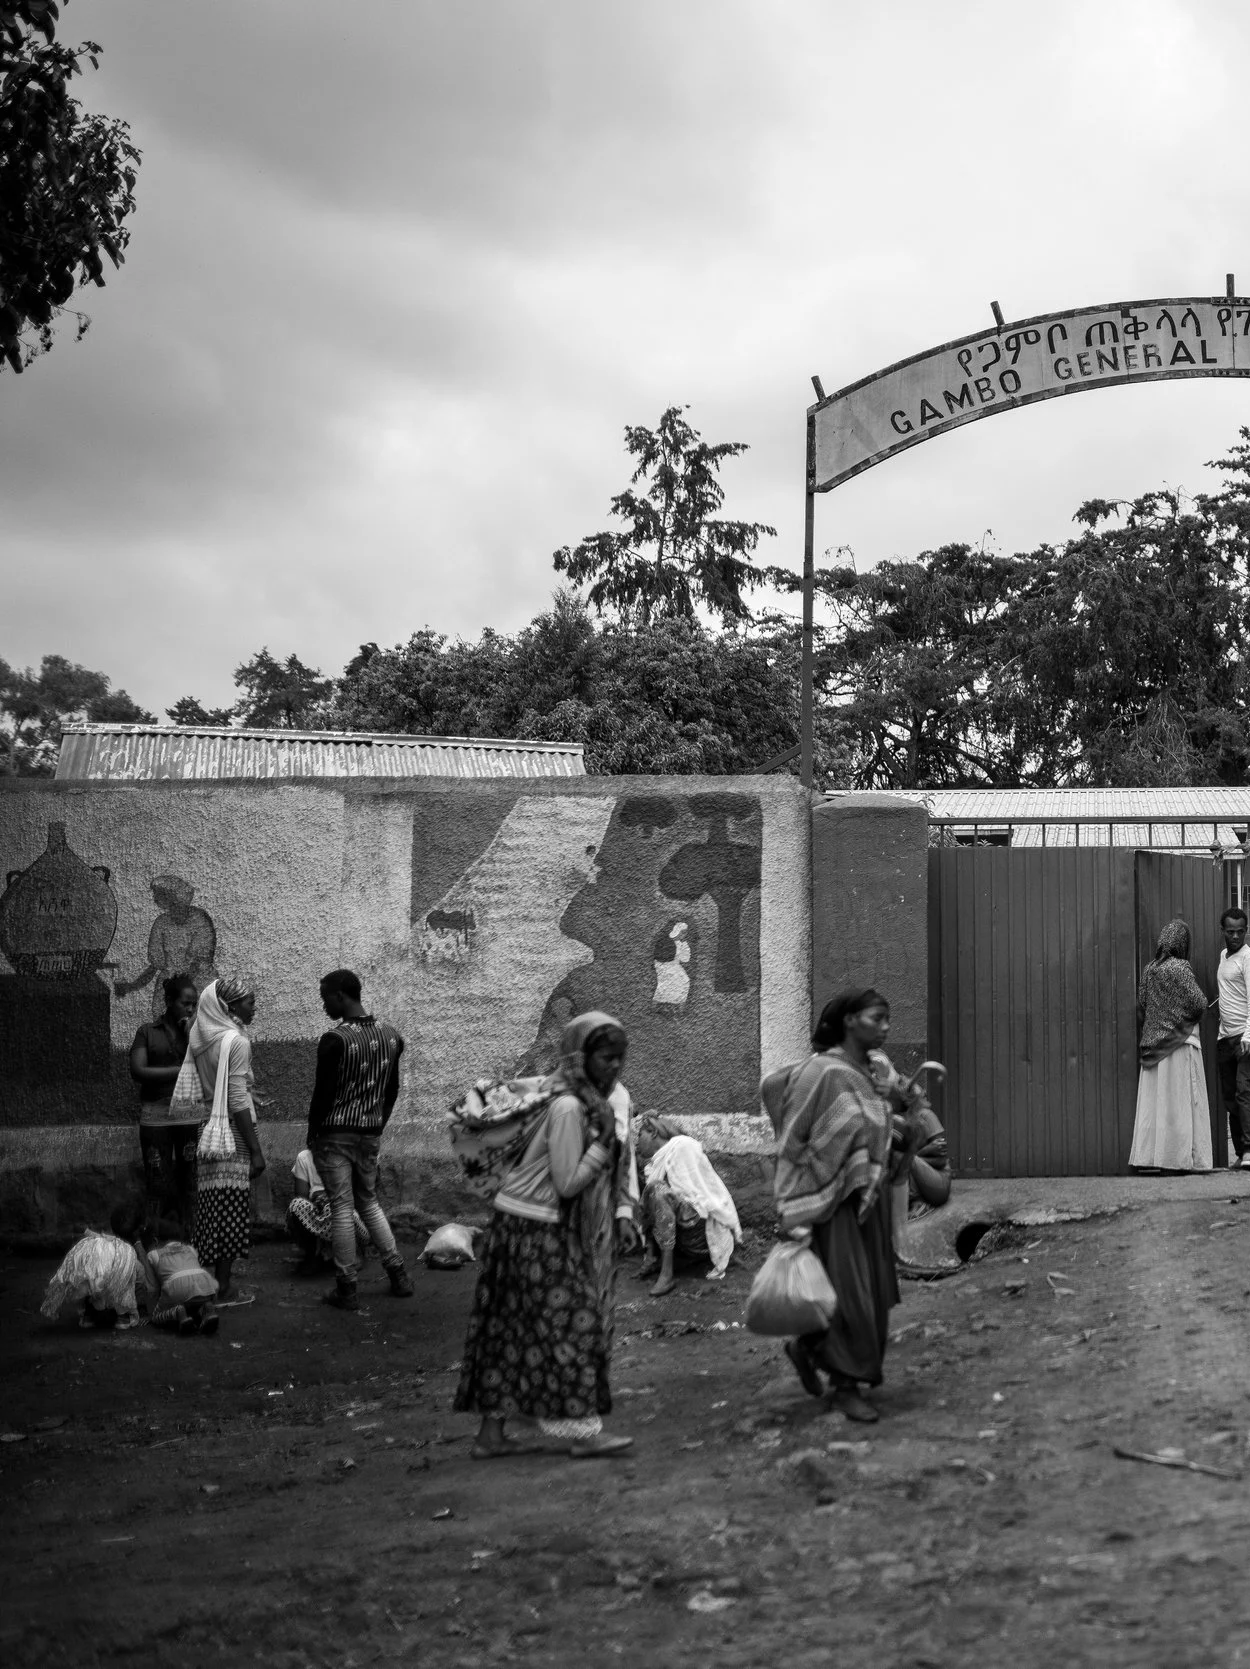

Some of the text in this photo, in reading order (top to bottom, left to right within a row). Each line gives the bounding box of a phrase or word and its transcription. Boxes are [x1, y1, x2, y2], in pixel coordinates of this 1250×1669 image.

[1085, 308, 1202, 347] ጠቅላላ
[890, 369, 1022, 435] GAMBO
[1054, 340, 1218, 381] GENERAL
